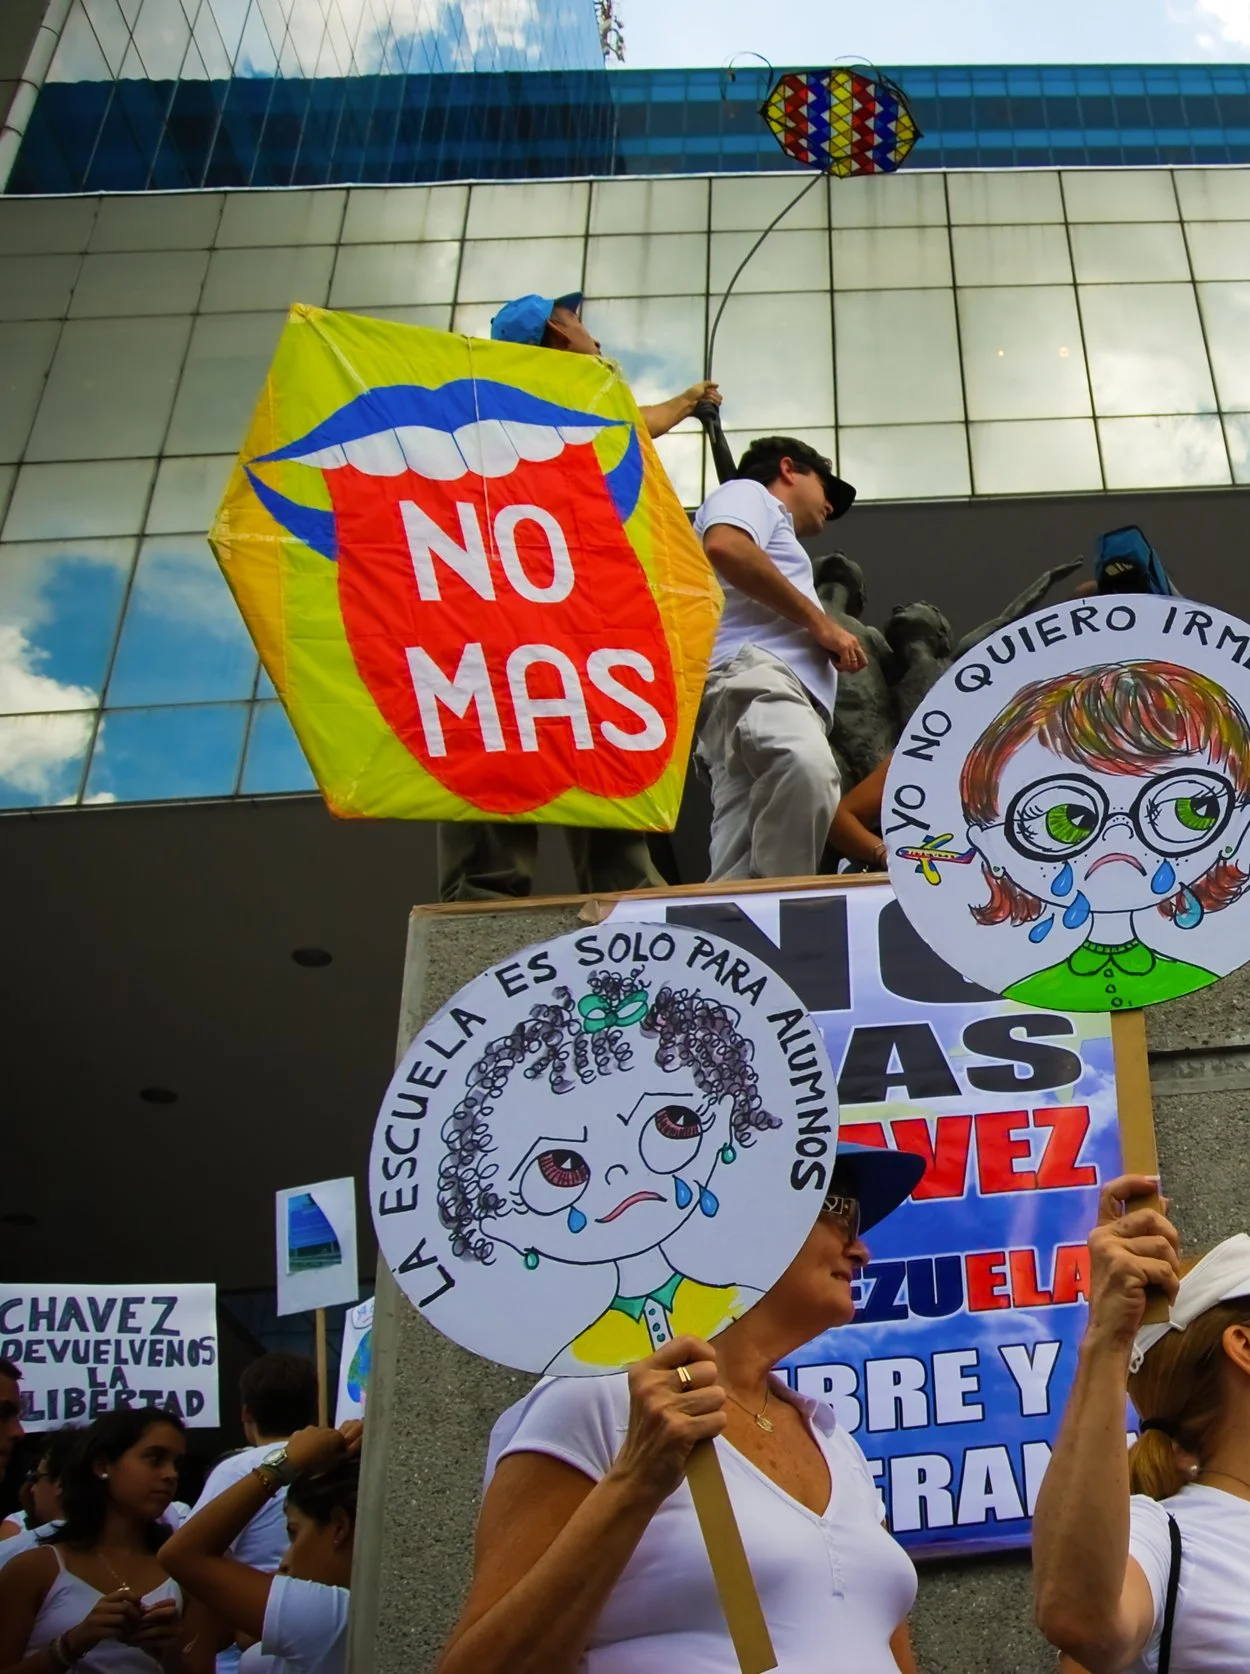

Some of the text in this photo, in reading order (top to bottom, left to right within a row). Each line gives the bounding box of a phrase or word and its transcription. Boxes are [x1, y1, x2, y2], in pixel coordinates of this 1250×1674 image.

[399, 500, 575, 603] NO
[955, 606, 1136, 693] QUIERO
[405, 642, 667, 757] MAS
[903, 709, 952, 762] NO
[886, 783, 931, 835] YO
[838, 1014, 1082, 1104] AS
[380, 932, 833, 1307] LA ESCUELA ES SOLO PARA ALUMNOS
[838, 1106, 1097, 1201] VEZ
[0, 1296, 180, 1336] CHAVEZ
[0, 1336, 216, 1367] DEVUELVENOS
[19, 1387, 205, 1422] LIBERTAD
[87, 1366, 129, 1389] LA
[770, 1340, 1062, 1434] BRE Y
